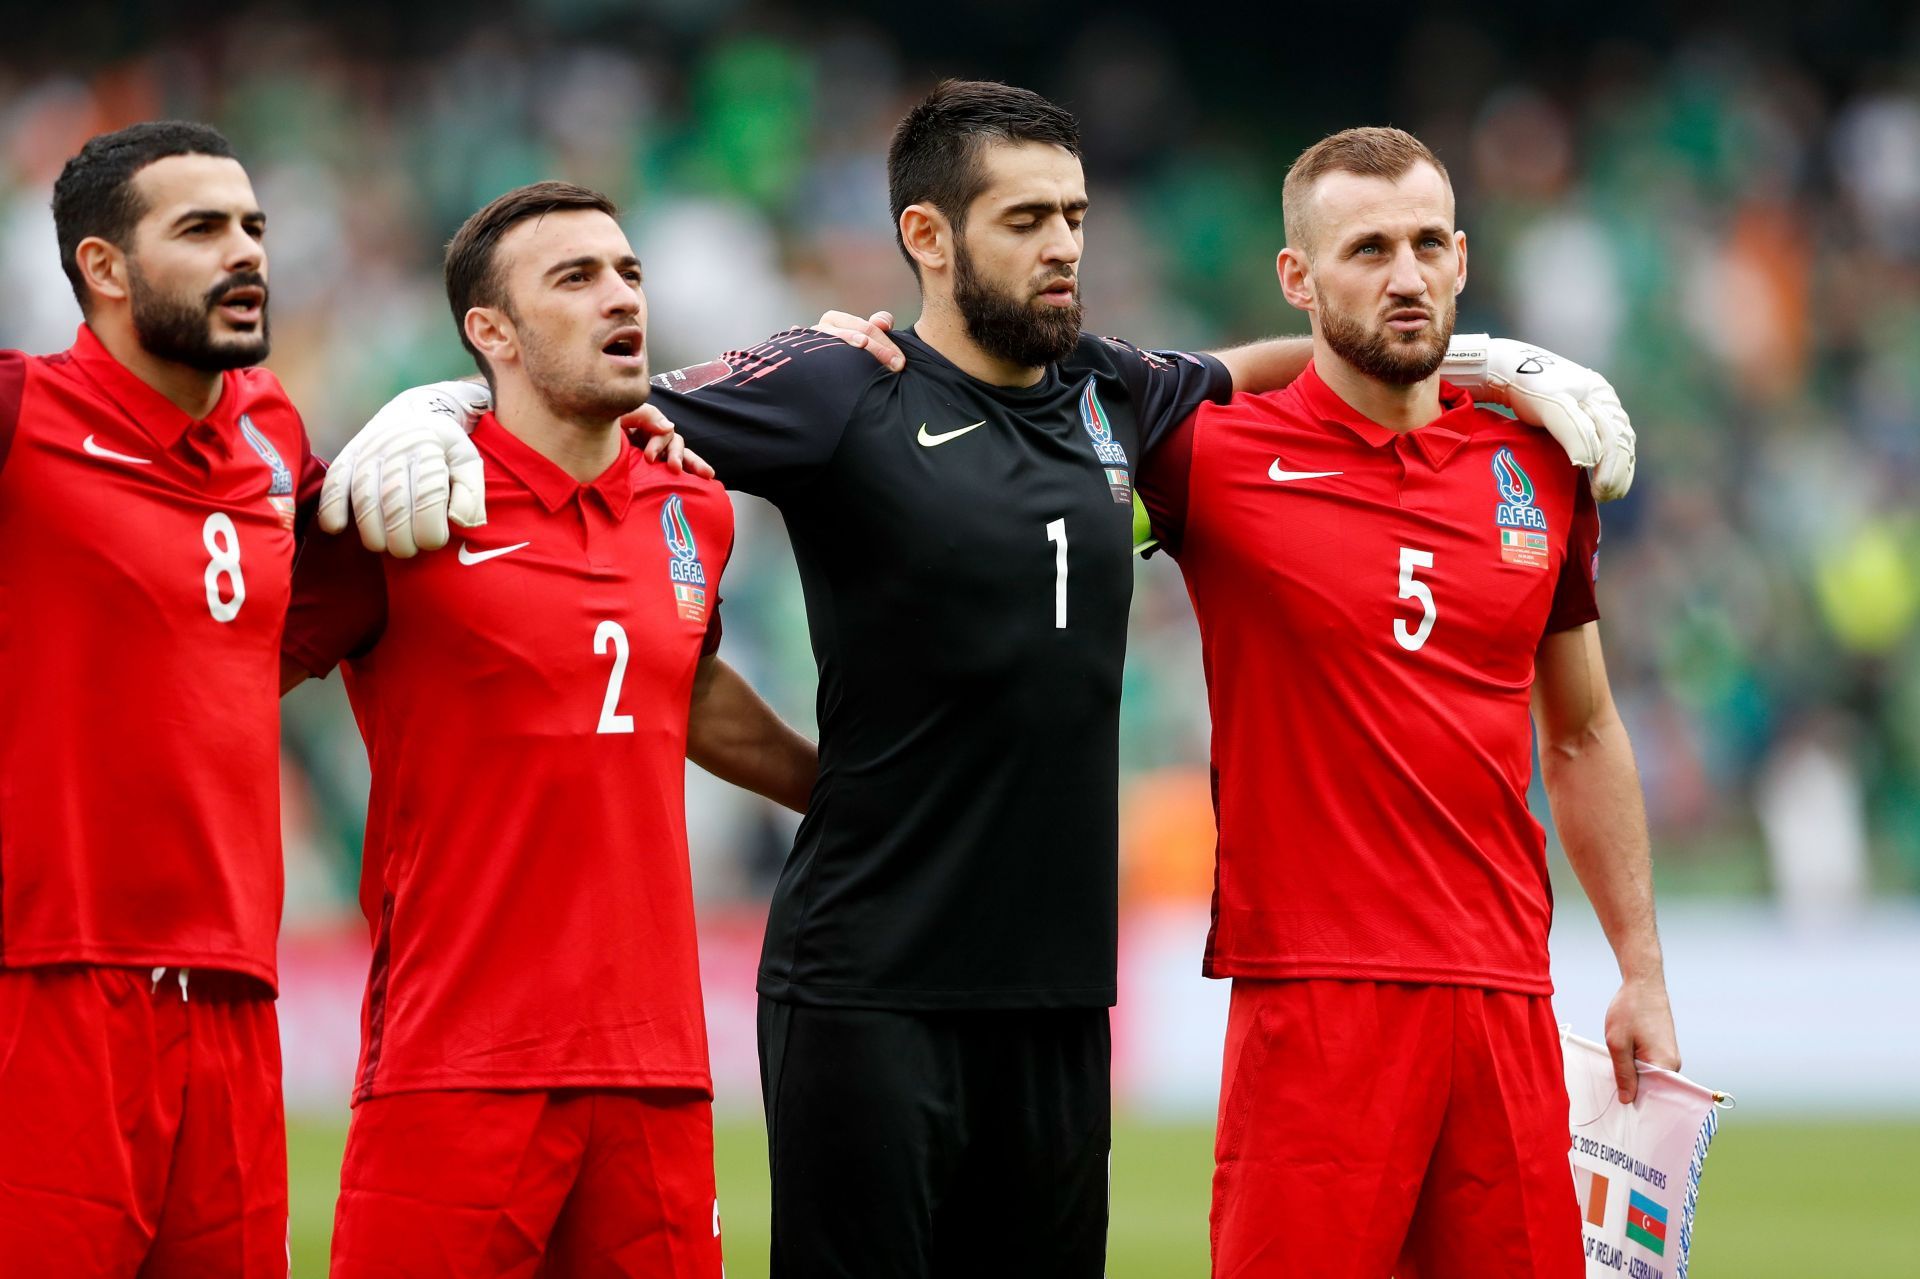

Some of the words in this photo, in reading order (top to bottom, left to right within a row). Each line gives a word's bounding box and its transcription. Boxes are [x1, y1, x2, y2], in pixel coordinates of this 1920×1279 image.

[1092, 443, 1128, 464] AFFA
[1497, 504, 1547, 529] AFFA
[203, 513, 245, 623] 8
[670, 559, 706, 584] AFFA
[1047, 518, 1069, 629] 1
[1394, 547, 1437, 651] 5
[594, 620, 635, 734] 2
[1580, 1136, 1599, 1157] 2022
[1600, 1144, 1634, 1174] EUROPEAN
[1634, 1160, 1667, 1190] QUALIFIERS
[1585, 1237, 1595, 1258] OF
[1595, 1240, 1623, 1271] IRELAND
